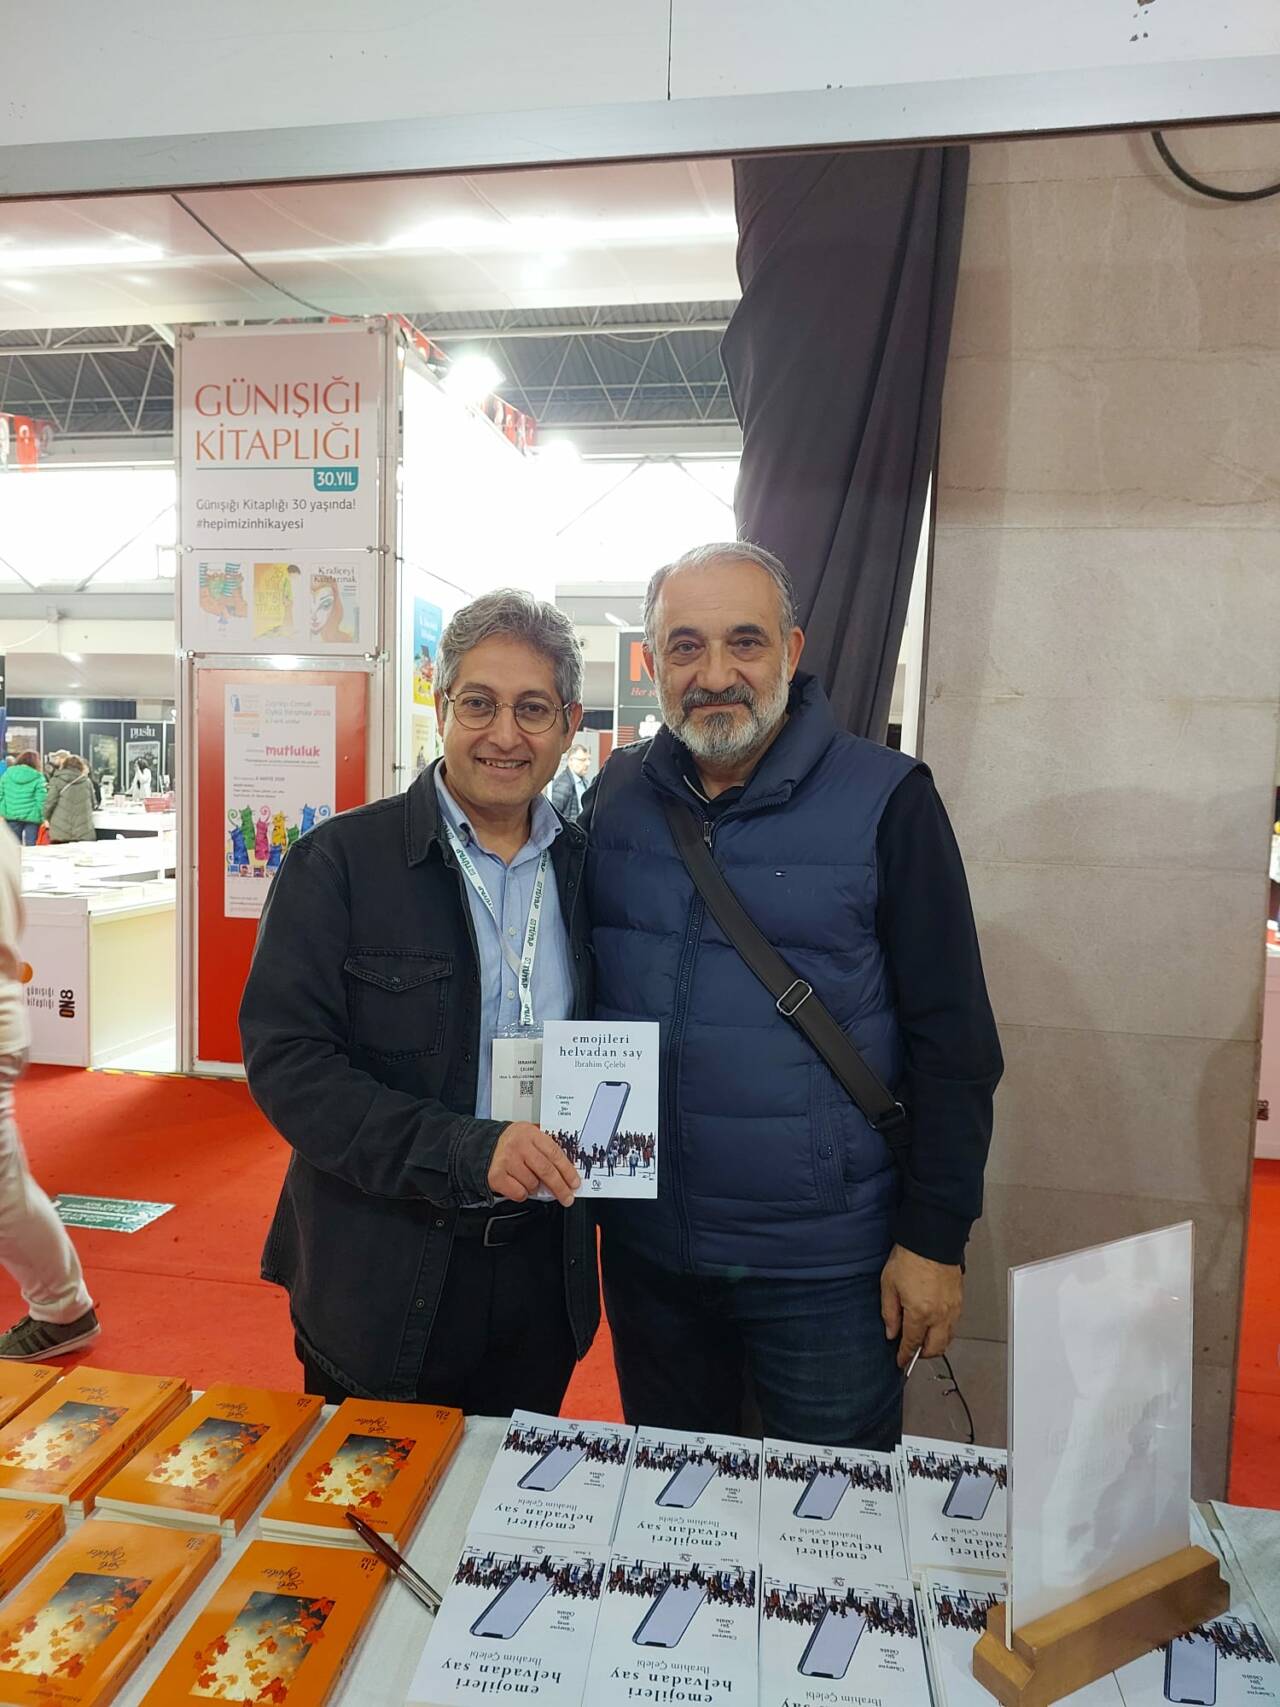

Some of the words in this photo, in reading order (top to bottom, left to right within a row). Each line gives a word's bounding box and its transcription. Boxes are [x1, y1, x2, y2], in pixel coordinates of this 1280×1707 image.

[195, 376, 360, 418] GÜNIŞIĞI
[196, 421, 359, 460] KİTAPLIĞI
[316, 472, 356, 486] 30.YIL
[196, 499, 240, 512] Günışığı
[242, 498, 289, 512] Kitaplığı
[292, 499, 307, 510] 30
[310, 498, 356, 513] yaşında!
[196, 518, 304, 531] #hepimizinhikayesi
[266, 745, 320, 757] mutluluk
[59, 989, 75, 1018] ON8
[572, 1033, 629, 1046] emojileri
[559, 1046, 617, 1057] helvadan
[622, 1049, 643, 1060] say
[604, 1060, 626, 1070] Çelebi
[494, 1503, 519, 1514] say
[525, 1508, 594, 1523] helvadan
[506, 1516, 576, 1531] emojileri
[636, 1520, 661, 1532] say
[668, 1525, 738, 1540] helvadan
[779, 1532, 804, 1543] say
[931, 1533, 956, 1543] say
[651, 1534, 722, 1548] emojileri
[810, 1537, 883, 1553] helvadan
[795, 1546, 867, 1561] emojileri
[468, 1650, 501, 1662] Çelebi
[440, 1657, 471, 1673] say
[636, 1659, 668, 1671] Çelebi
[479, 1664, 562, 1684] helvadan
[610, 1666, 640, 1682] say
[455, 1677, 539, 1695] emojileri
[648, 1673, 732, 1692] helvadan
[628, 1687, 712, 1704] emojileri
[806, 1691, 838, 1704] Çelebi
